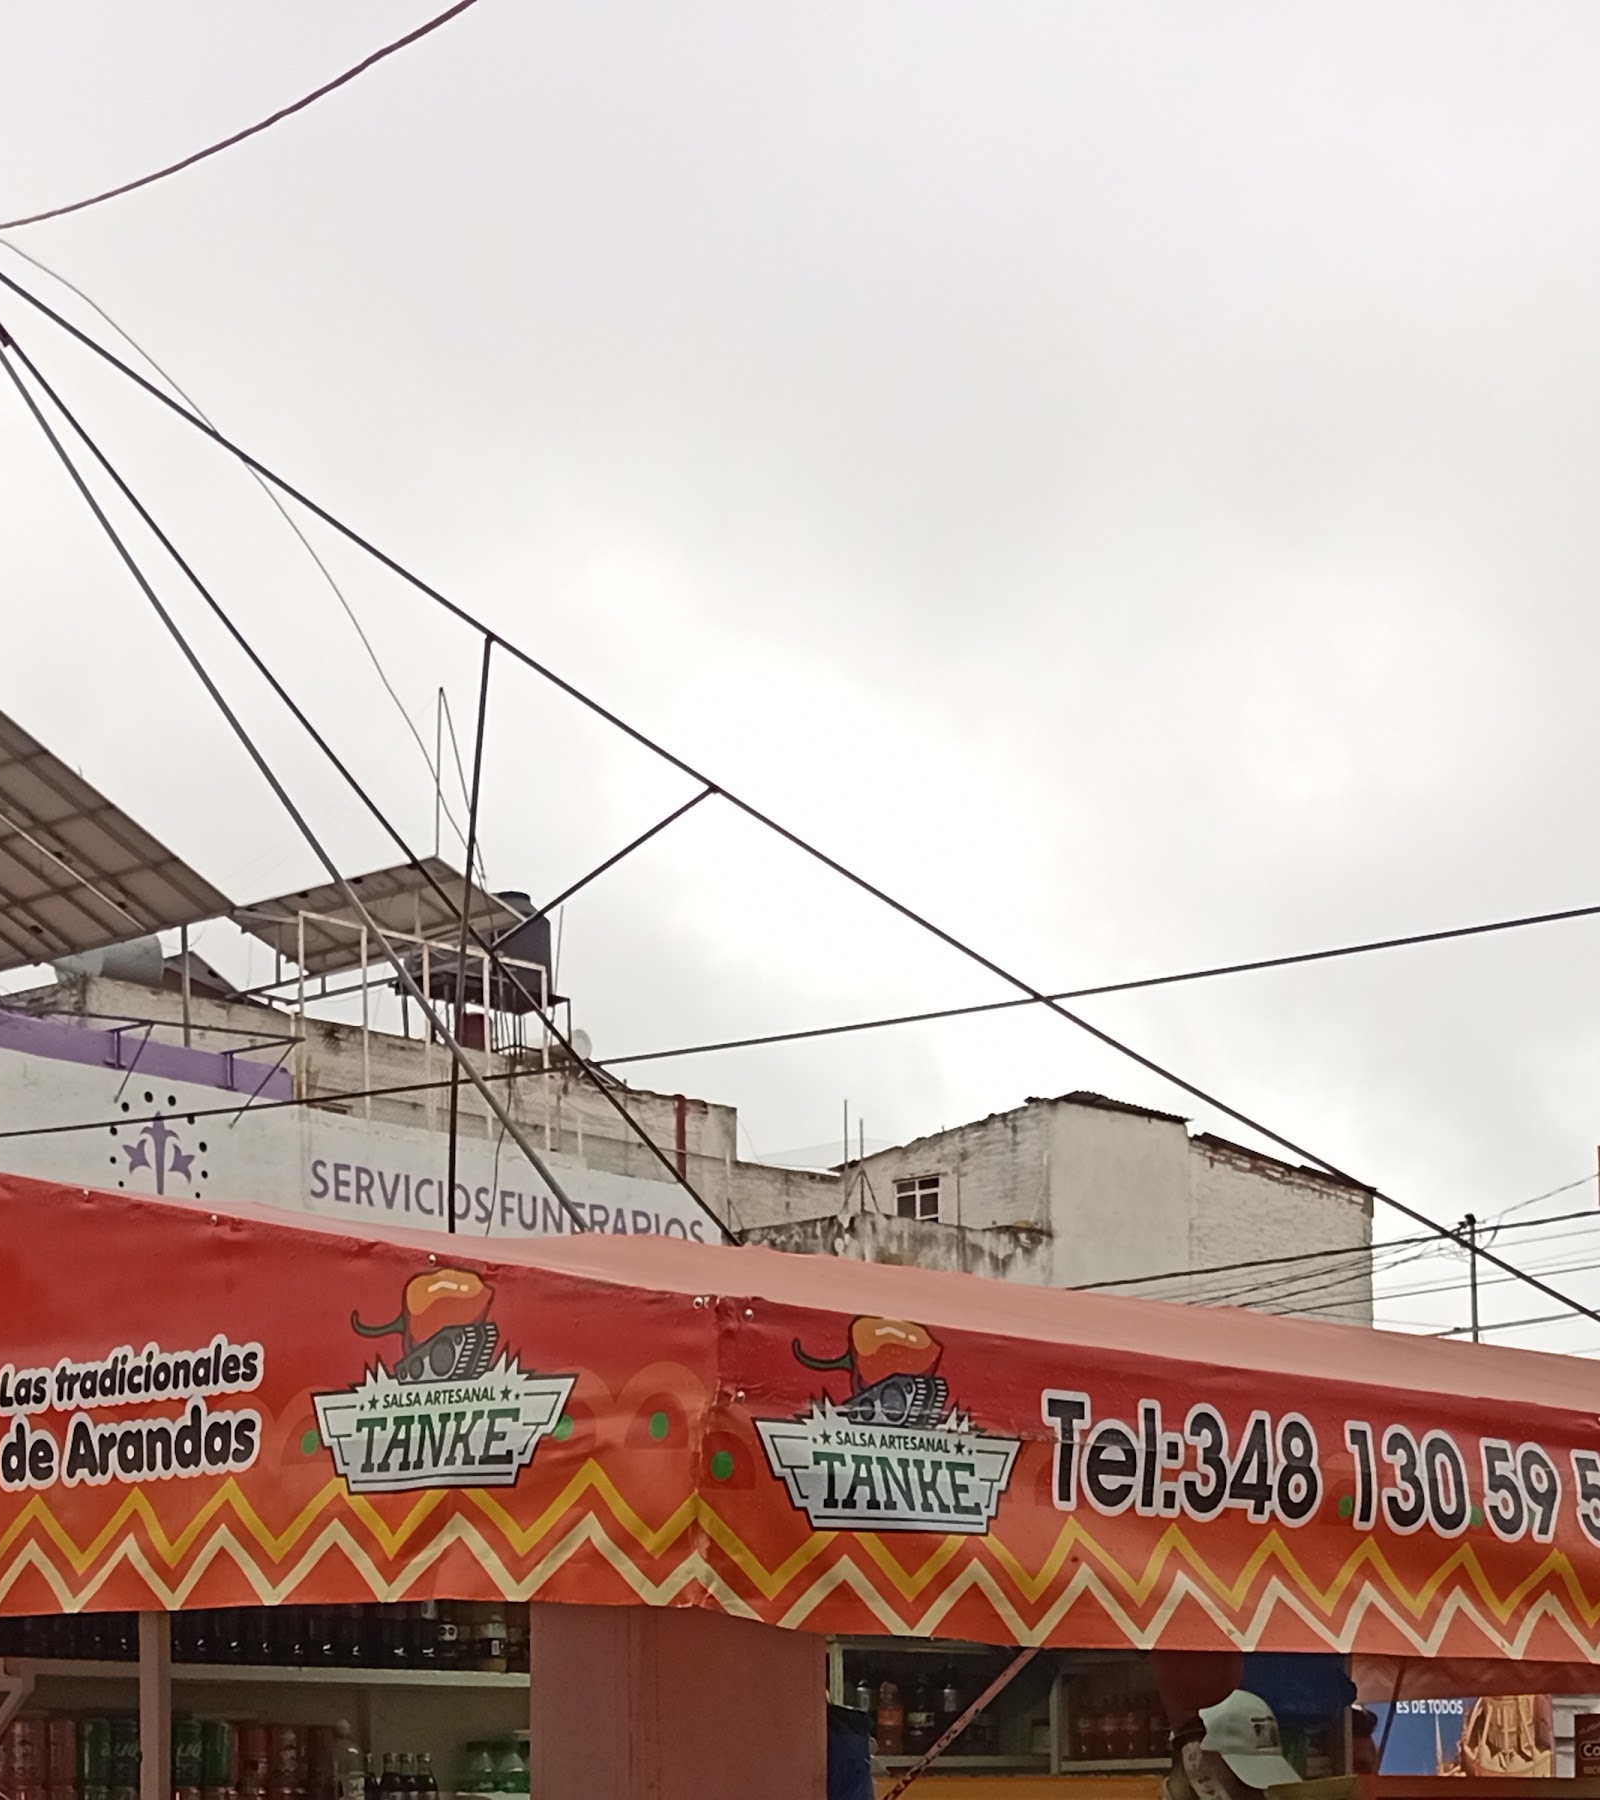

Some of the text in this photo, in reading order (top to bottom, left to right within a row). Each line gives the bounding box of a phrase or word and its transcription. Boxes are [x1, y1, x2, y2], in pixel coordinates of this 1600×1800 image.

[311, 1159, 490, 1224] SERVICIOS
[0, 1342, 259, 1408] Las tradicionales
[382, 1386, 496, 1410] SALSA ARTESANAL
[1, 1404, 257, 1484] de Arandas
[356, 1407, 521, 1474] TANKE
[835, 1430, 950, 1454] SALSA ARTESANAL
[812, 1451, 983, 1516] TANKE
[1345, 1427, 1467, 1533] 130
[1488, 1441, 1559, 1542] 59
[1411, 1699, 1426, 1714] DE
[1427, 1699, 1464, 1715] TODOS
